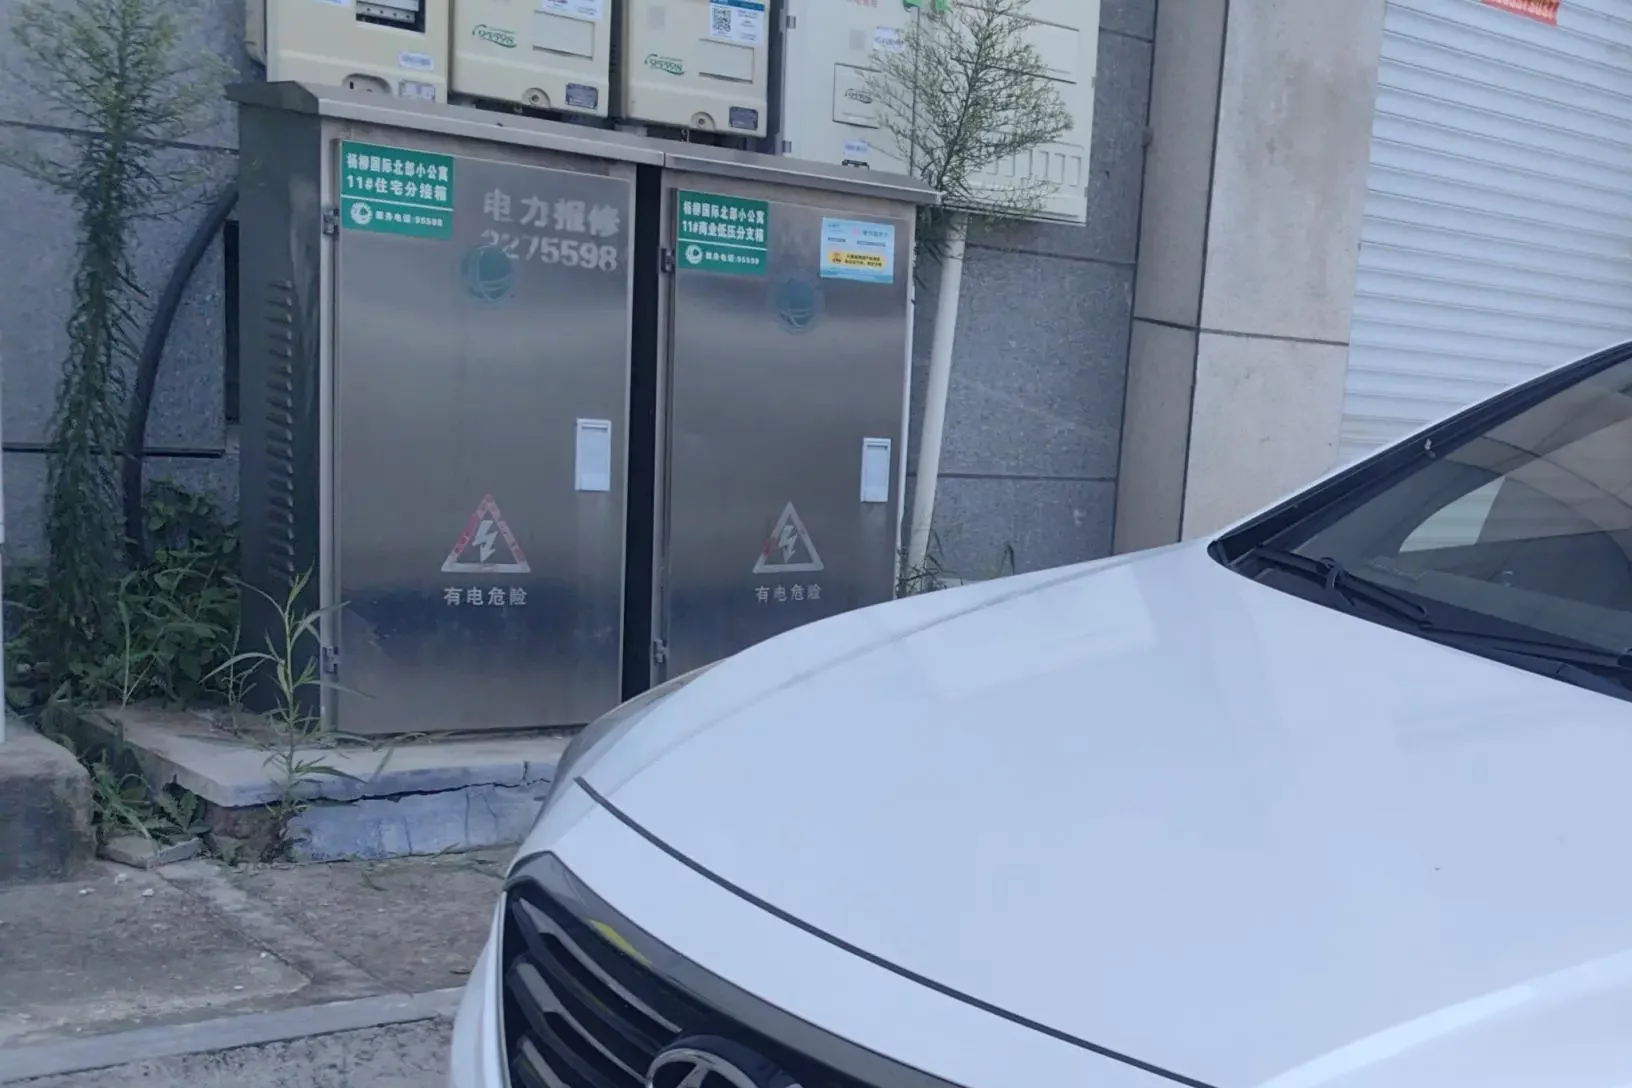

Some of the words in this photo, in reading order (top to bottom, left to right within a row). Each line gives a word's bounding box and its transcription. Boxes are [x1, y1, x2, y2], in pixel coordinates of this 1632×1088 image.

[483, 188, 620, 237] 电力报修
[443, 586, 528, 606] 有电危险
[754, 583, 822, 604] 有电危险
